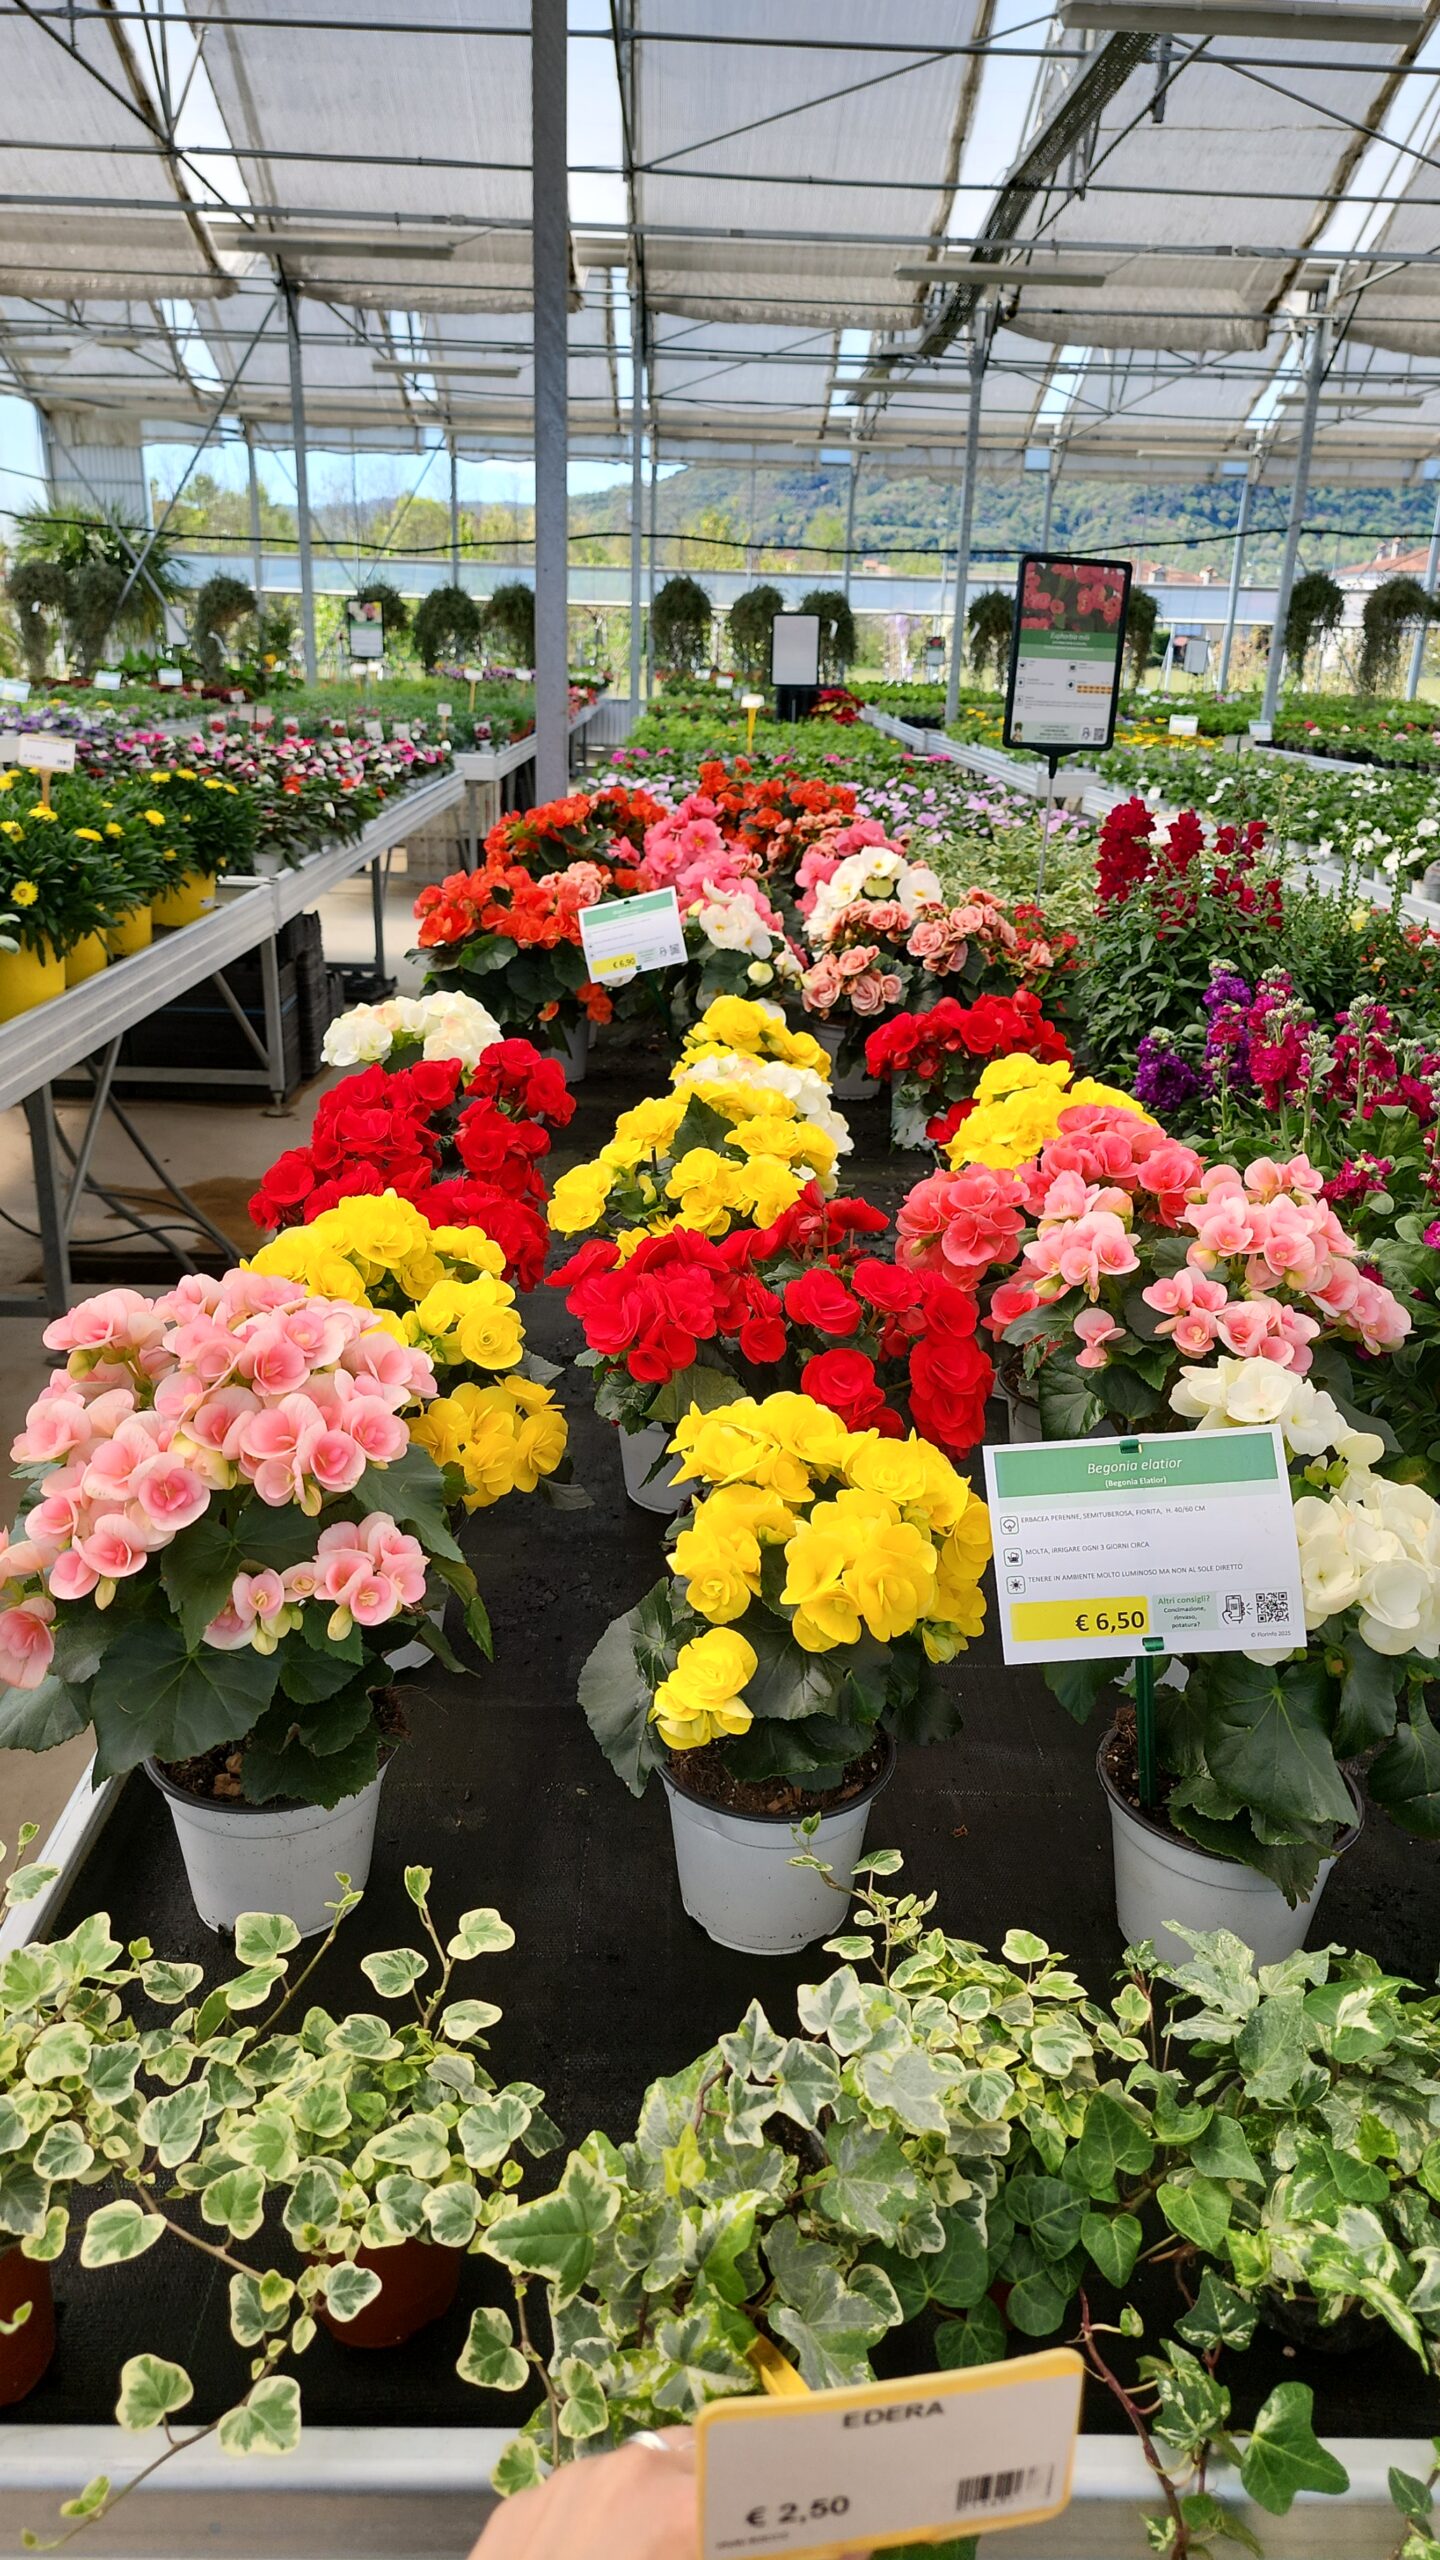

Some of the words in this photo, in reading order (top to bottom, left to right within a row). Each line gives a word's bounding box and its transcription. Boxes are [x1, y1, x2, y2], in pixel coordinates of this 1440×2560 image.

[1087, 1461, 1137, 1476] Begonia
[1141, 1458, 1183, 1471] elatior
[1105, 1478, 1138, 1488] (Begonia
[1139, 1476, 1167, 1486] Elatior)
[1021, 1515, 1049, 1523] ERBACEA
[1050, 1512, 1082, 1522] PERENNE,
[1083, 1509, 1135, 1519] SEMITUBEROSA,
[1136, 1507, 1163, 1516] FIORITA,
[1174, 1505, 1193, 1514] 40/60
[1025, 1547, 1050, 1556] MOLTA,
[1082, 1544, 1099, 1552] OGNI
[1105, 1542, 1129, 1551] GIORNI
[1131, 1541, 1150, 1549] CIRCA
[1028, 1575, 1052, 1583] TENERE
[1062, 1572, 1096, 1581] AMBIENTE
[1096, 1571, 1121, 1579] MOLTO
[1121, 1568, 1158, 1578] LUMINOSO
[1159, 1567, 1170, 1575] MA
[1172, 1566, 1187, 1574] NON
[1188, 1565, 1197, 1573] AL
[1197, 1564, 1213, 1572] SOLE
[1215, 1563, 1243, 1571] DIRETTO
[1158, 1597, 1175, 1605] Altri
[1177, 1595, 1210, 1604] consigli?
[1075, 1614, 1090, 1631] €
[1096, 1610, 1145, 1633] 6,50
[1171, 1621, 1201, 1629] potatura?
[843, 2400, 945, 2430] EDERA
[745, 2505, 767, 2528] €
[778, 2495, 850, 2526] 2,50
